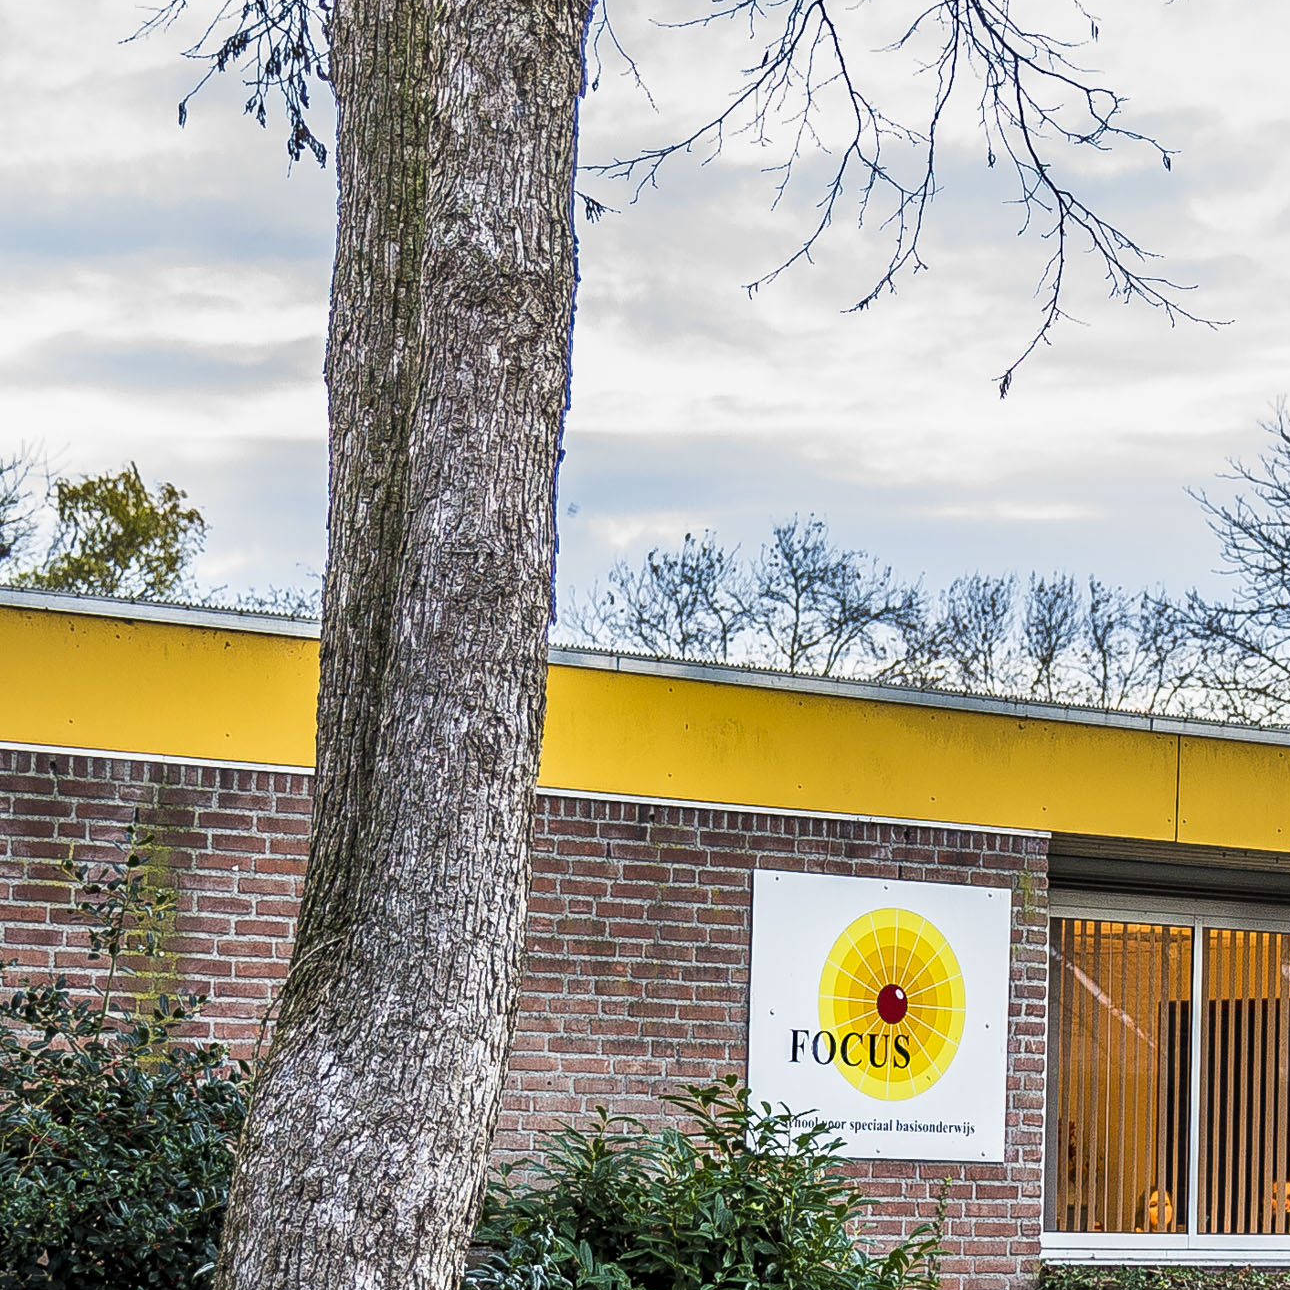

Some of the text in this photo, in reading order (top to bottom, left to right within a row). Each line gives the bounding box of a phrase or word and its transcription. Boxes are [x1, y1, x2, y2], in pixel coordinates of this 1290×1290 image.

[788, 1029, 911, 1069] FOCUS
[849, 1119, 893, 1134] speciaal
[896, 1120, 975, 1137] basisonderwijs
